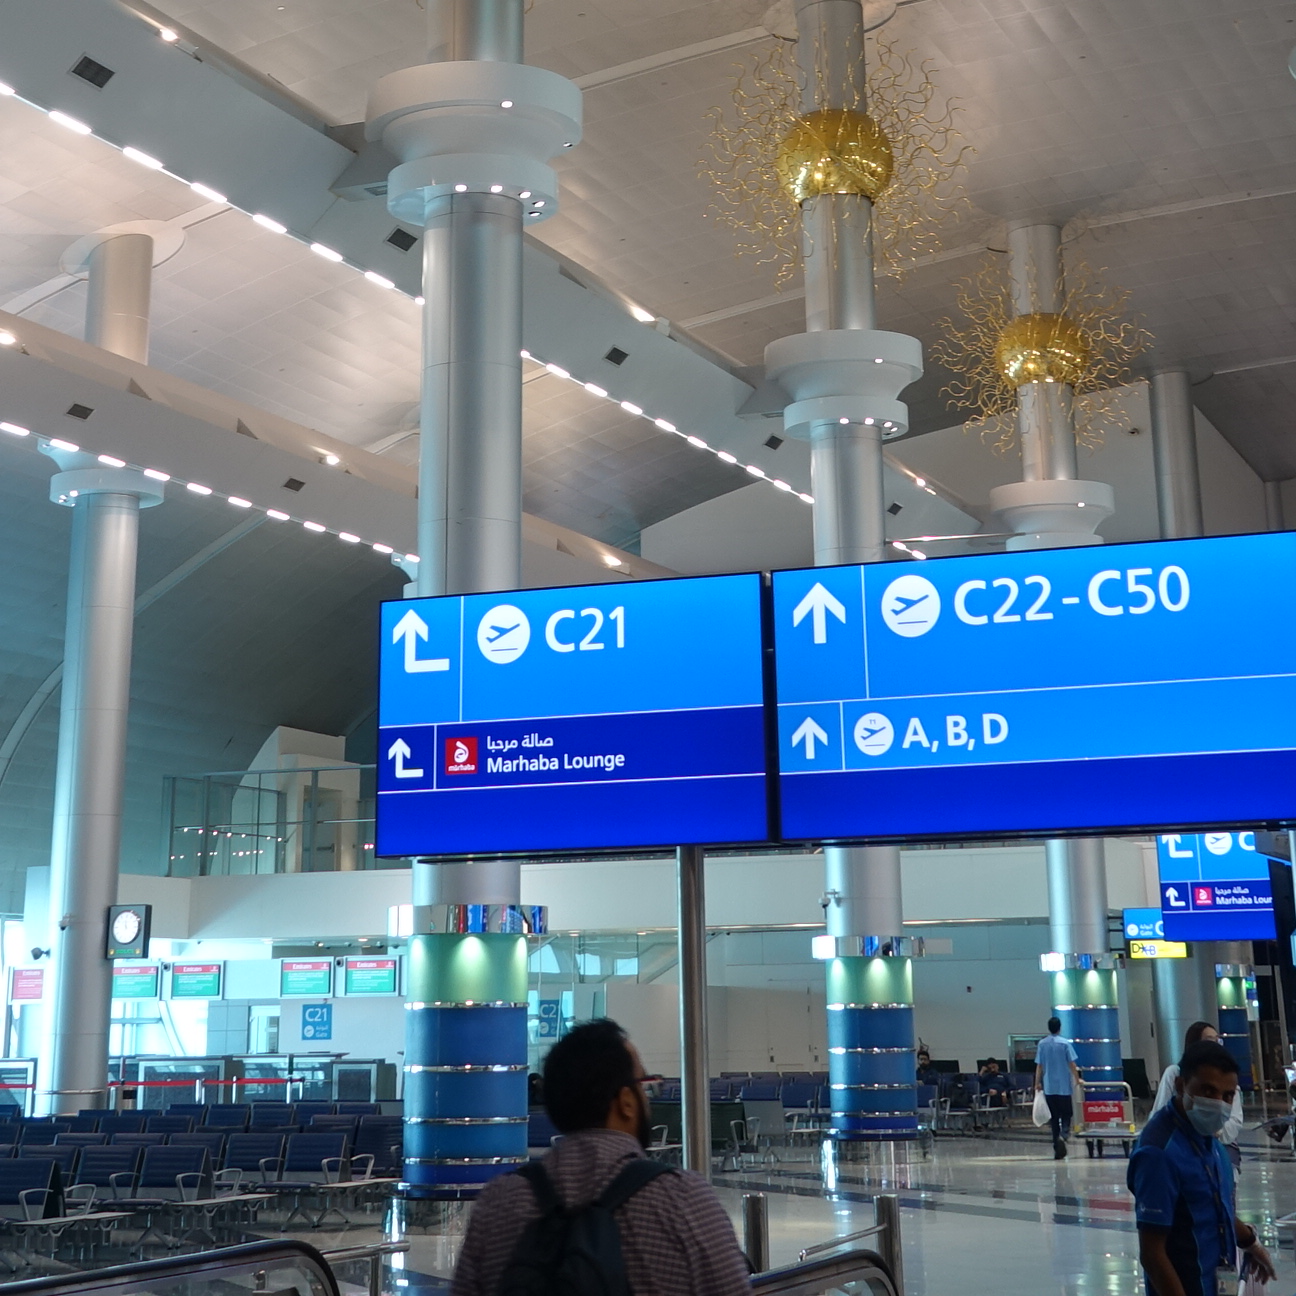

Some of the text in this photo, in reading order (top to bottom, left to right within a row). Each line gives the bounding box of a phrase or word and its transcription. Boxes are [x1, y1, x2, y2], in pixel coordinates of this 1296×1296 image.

[545, 606, 625, 653] C21
[487, 733, 554, 753] صالة مرحبا
[487, 753, 626, 773] Marhaba Lounge
[1216, 896, 1252, 905] Marhaba
[305, 1008, 327, 1022] C21
